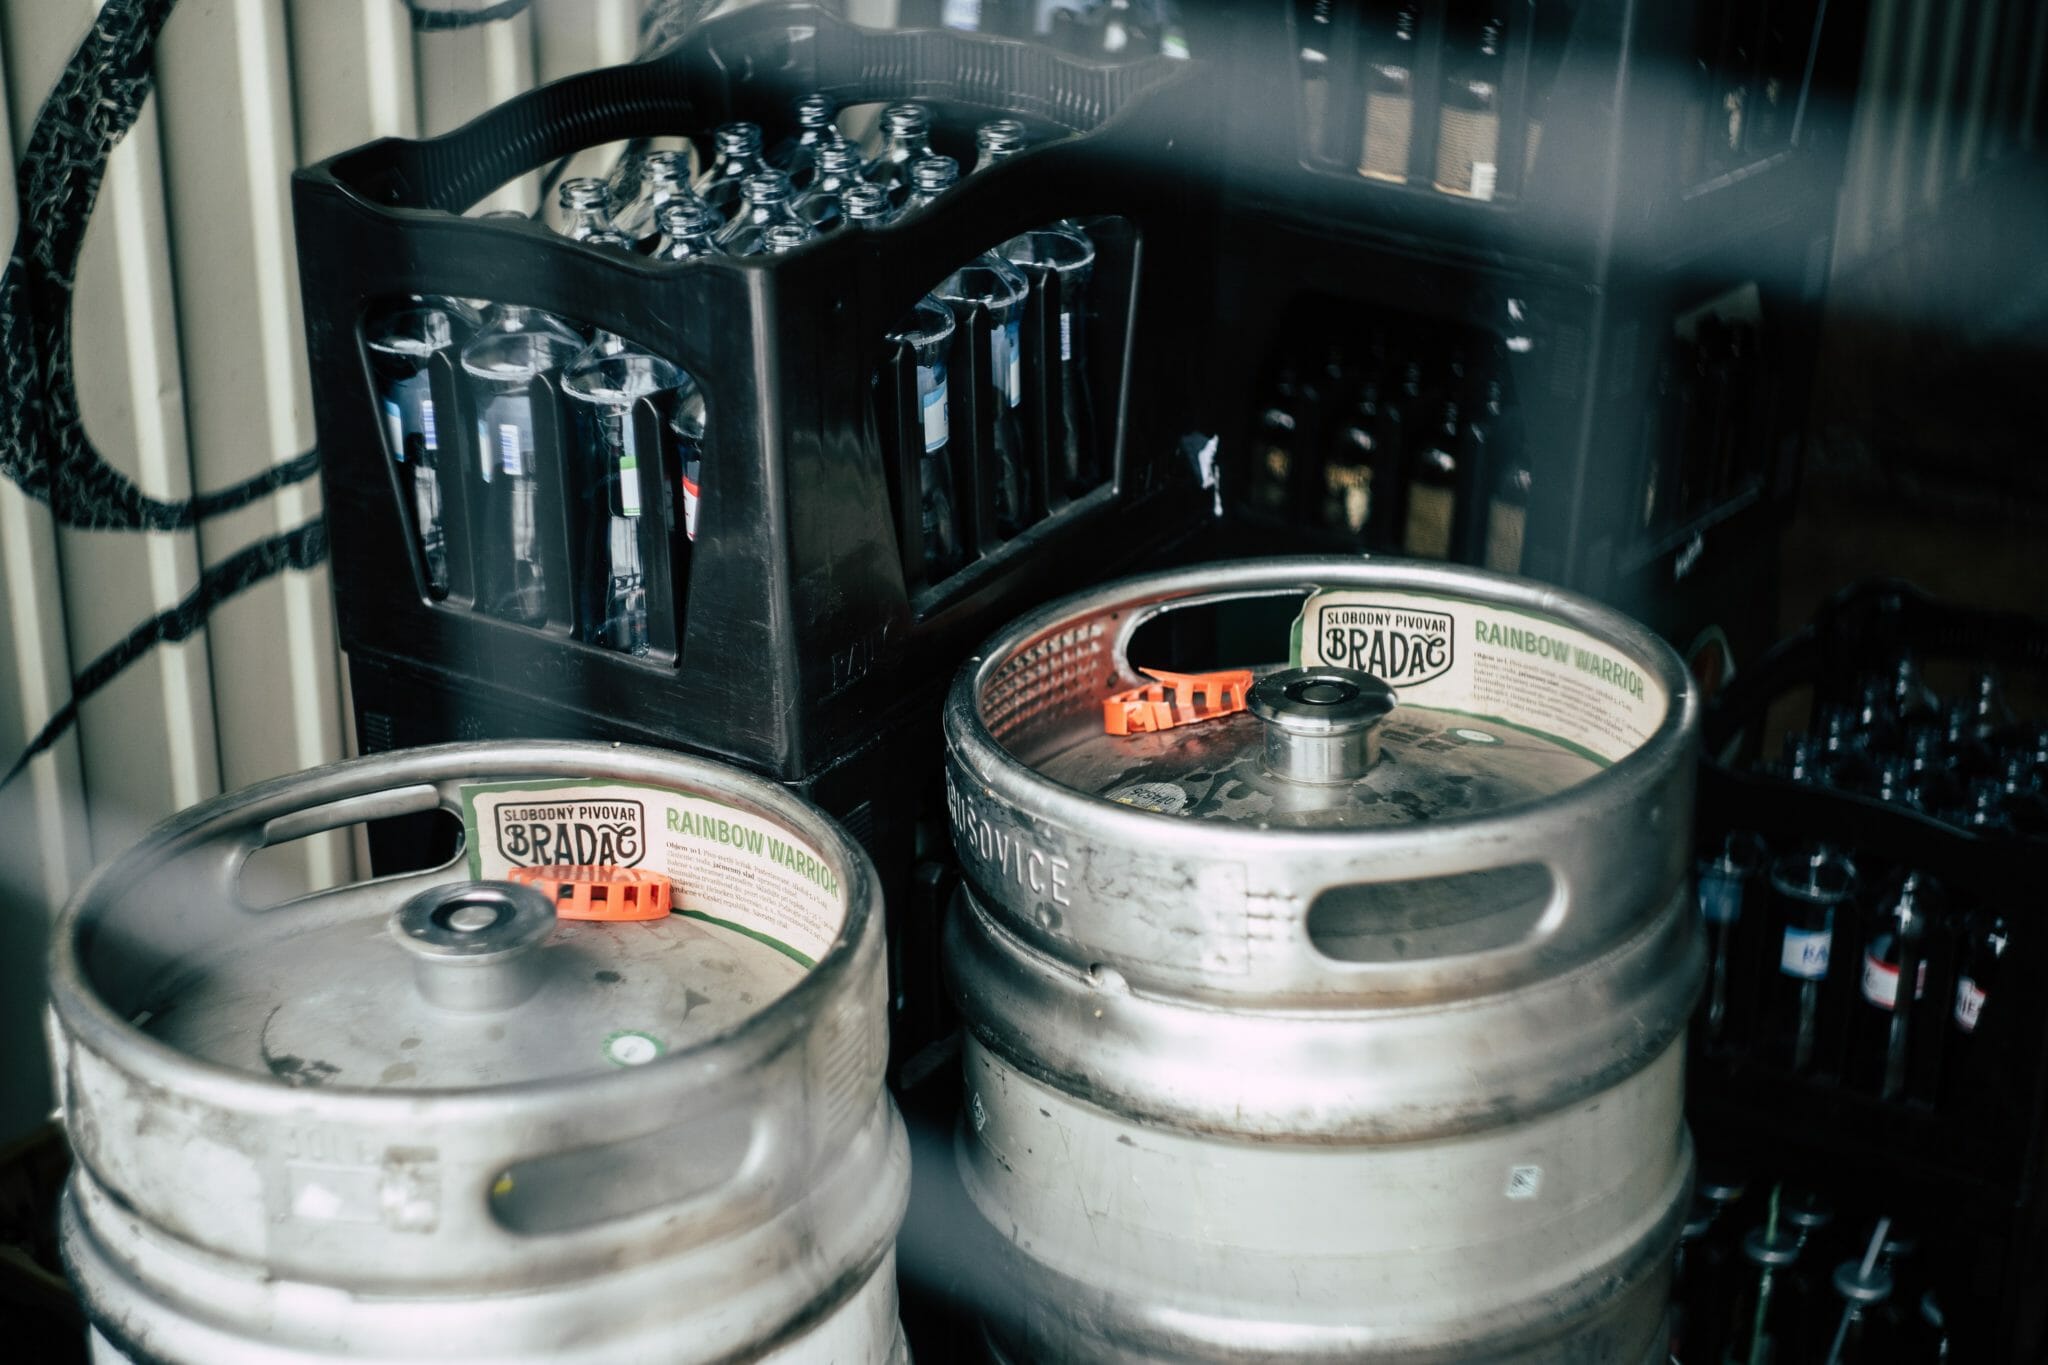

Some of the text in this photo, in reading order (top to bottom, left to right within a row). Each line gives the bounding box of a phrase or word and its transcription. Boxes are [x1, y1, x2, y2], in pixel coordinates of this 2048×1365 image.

[1327, 611, 1446, 633] SLOBODNÝ PIVOVAR
[1326, 628, 1446, 678] BRADAČ
[1475, 619, 1570, 664] RAINBOW
[1573, 646, 1644, 702] WARRIOR
[504, 805, 636, 822] SLOBODNÝ PIVOVAR
[504, 823, 637, 866] BRADAČ
[666, 807, 764, 857] RAINBOW
[767, 835, 840, 901] WARRIOR
